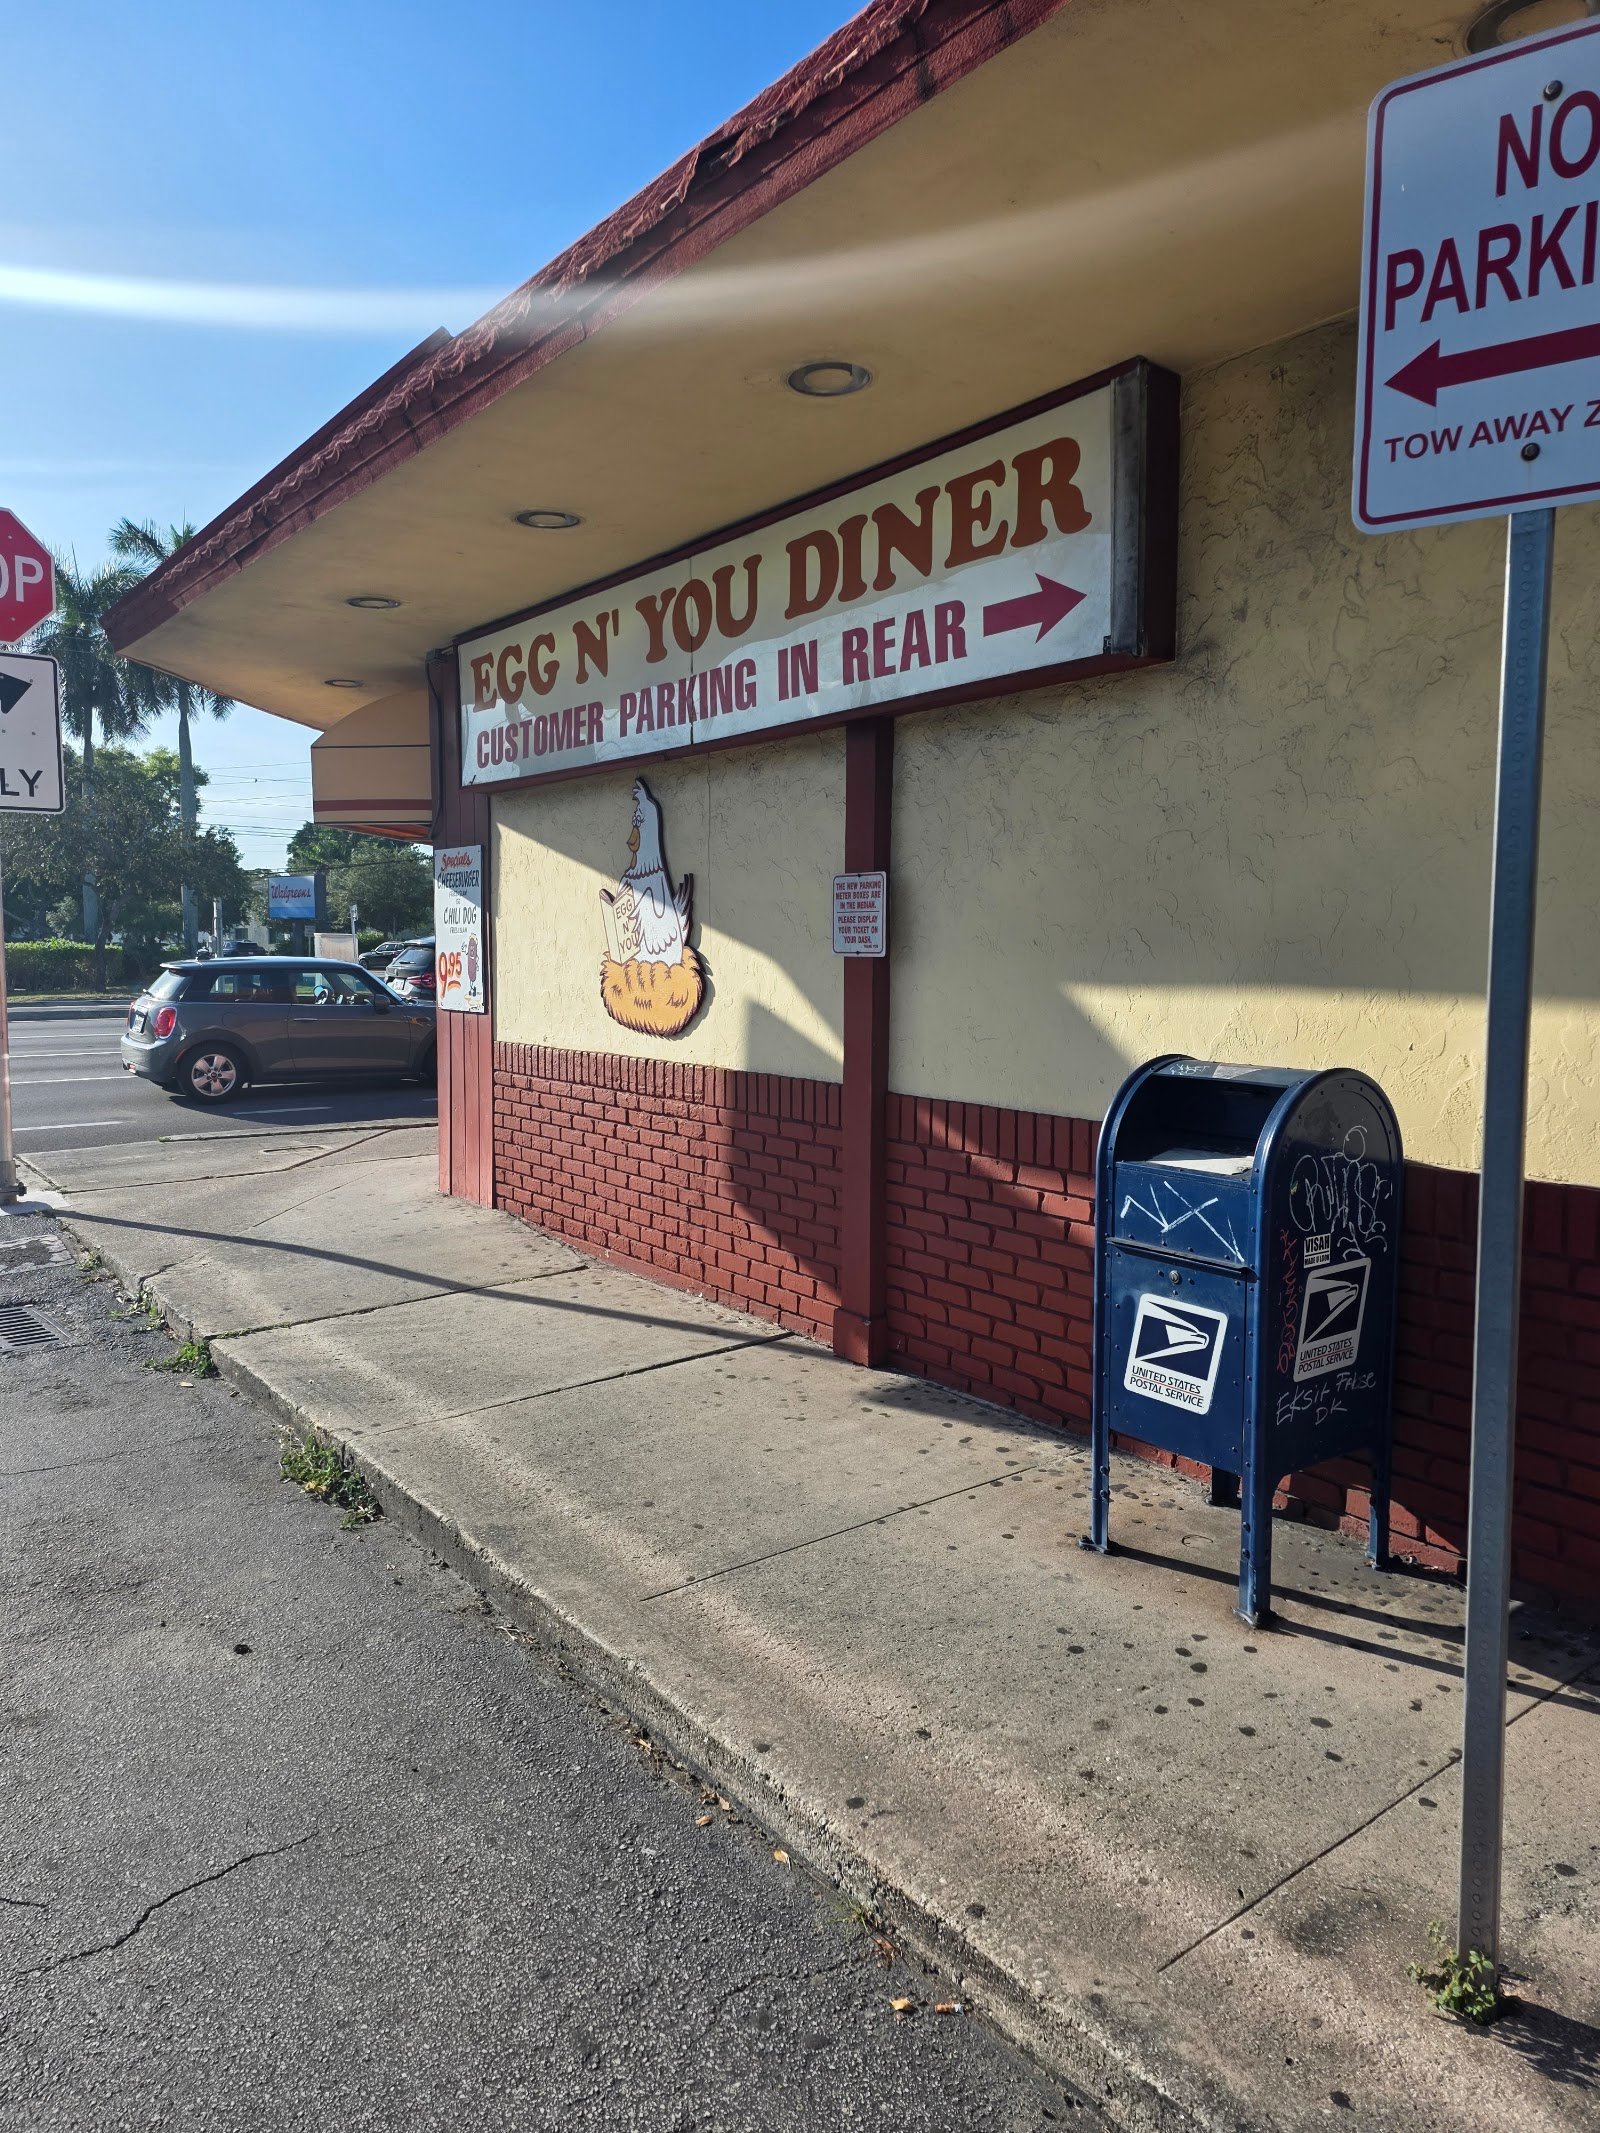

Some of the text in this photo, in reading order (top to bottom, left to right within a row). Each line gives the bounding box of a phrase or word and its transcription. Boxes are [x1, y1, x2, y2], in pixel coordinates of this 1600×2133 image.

[1496, 90, 1600, 198] NO
[1385, 200, 1599, 331] PARKI
[1384, 425, 1463, 463] TOW
[1468, 404, 1575, 448] AWAY
[470, 437, 1092, 713] EGG N' YOU DINER
[476, 600, 968, 769] CUSTOMER PARKING IN REAR
[441, 851, 473, 871] Specials
[271, 884, 311, 903] Walgreens
[836, 881, 881, 891] THE NEW PARKING
[836, 890, 881, 900] METER BOXES ARE
[443, 905, 477, 924] CHILI DOG
[616, 899, 632, 919] EGG
[847, 901, 855, 909] THE
[858, 915, 878, 923] DISPLAY
[844, 936, 856, 944] YOUR
[853, 926, 869, 934] TICKET
[620, 934, 640, 953] YOU
[1305, 1235, 1329, 1253] VISAH
[1300, 1337, 1353, 1361] UNITED STATES
[1298, 1349, 1354, 1374] POSTAL SERVICE
[1132, 1365, 1201, 1394] UNITED STATES
[1130, 1376, 1204, 1408] POSTAL SERVICE
